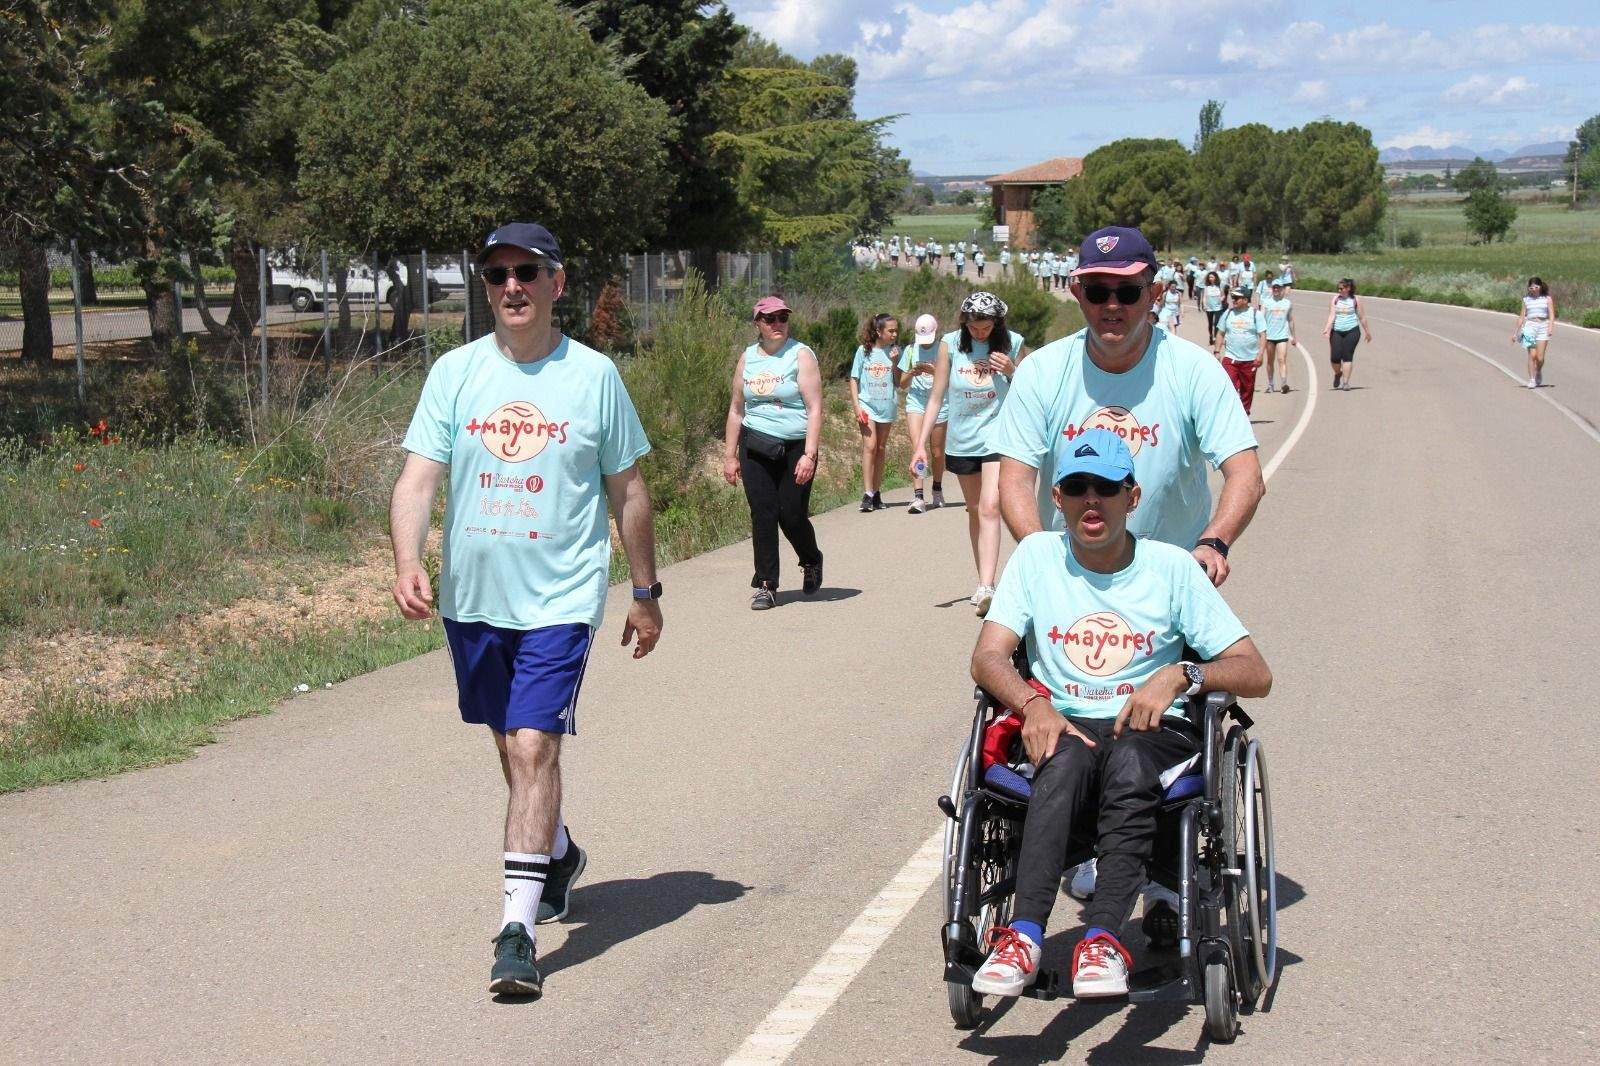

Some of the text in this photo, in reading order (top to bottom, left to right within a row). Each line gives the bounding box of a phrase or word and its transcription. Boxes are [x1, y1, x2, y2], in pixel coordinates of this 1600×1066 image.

[466, 418, 570, 447] +mayores
[1063, 423, 1160, 447] +ores
[479, 472, 492, 488] 11
[1047, 625, 1156, 660] +mayores
[1064, 683, 1079, 698] 11
